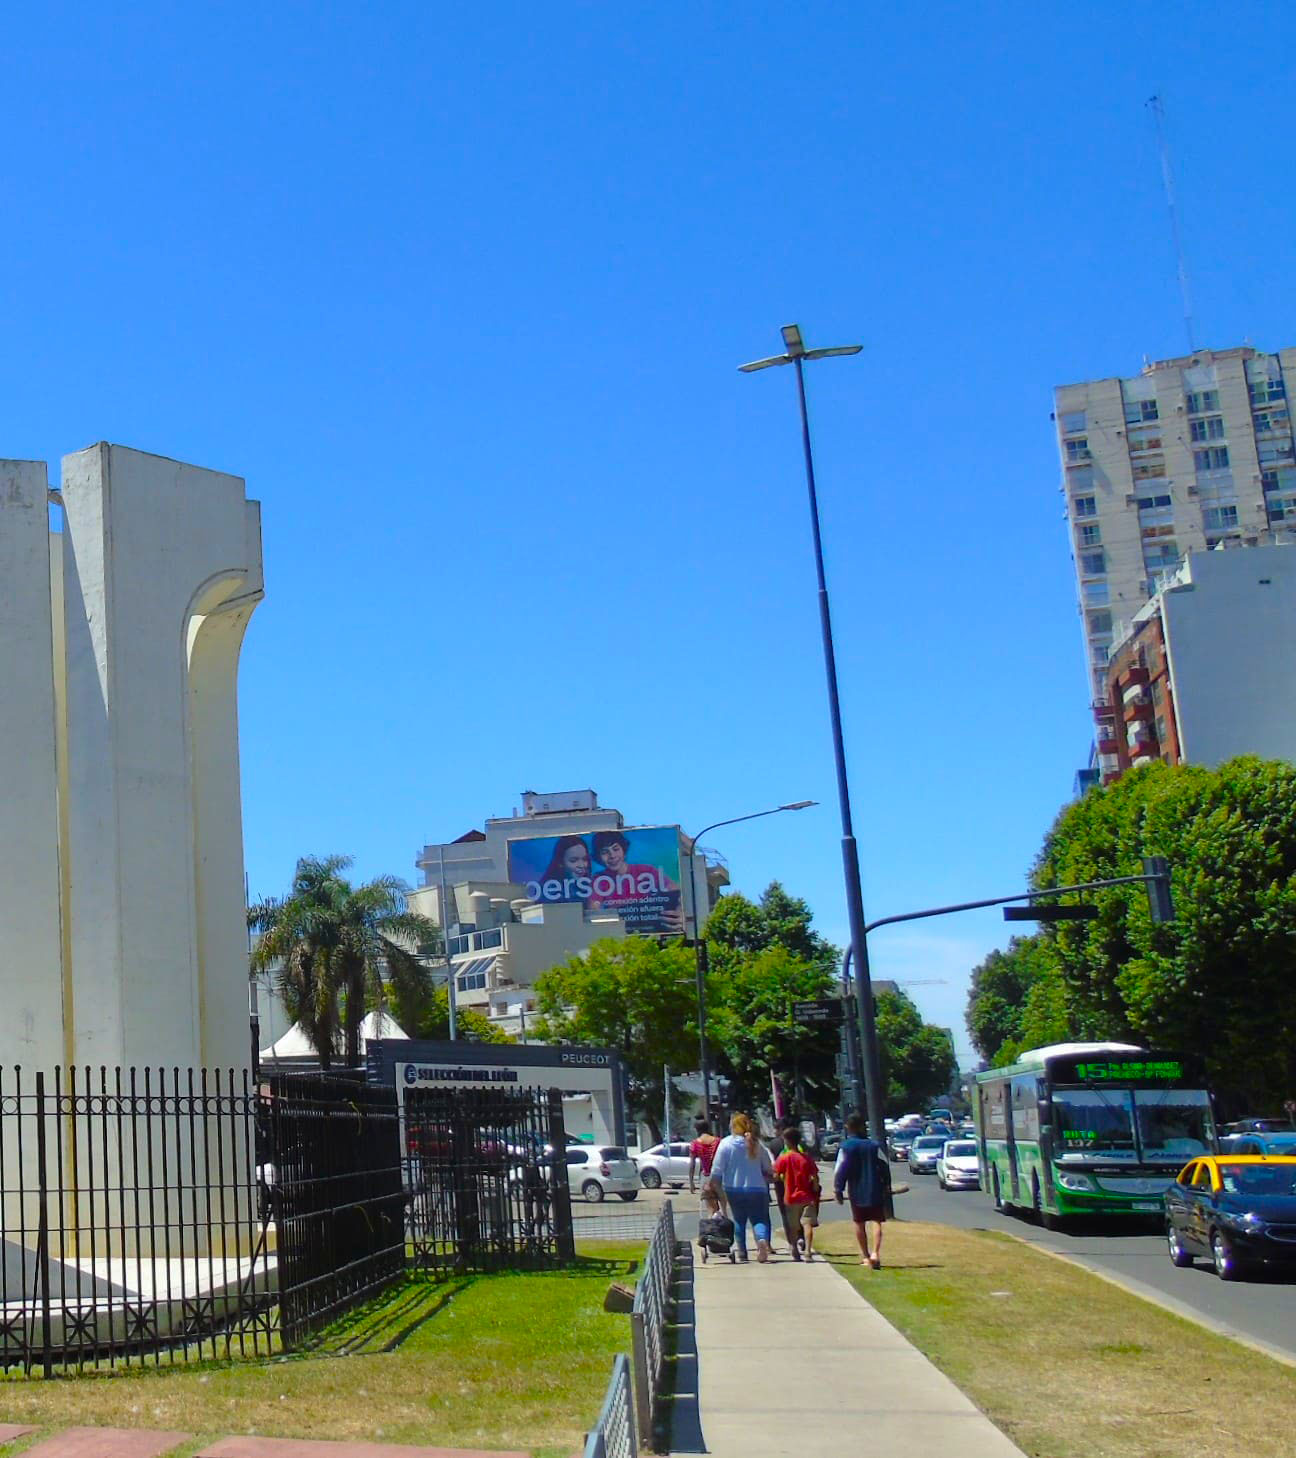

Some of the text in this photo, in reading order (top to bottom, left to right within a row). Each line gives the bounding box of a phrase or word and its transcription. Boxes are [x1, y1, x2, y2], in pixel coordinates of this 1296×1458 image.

[639, 895, 669, 903] adentro
[561, 1053, 610, 1065] PEUGEOT
[1075, 1063, 1106, 1079] 15
[1062, 1130, 1097, 1139] RUTA
